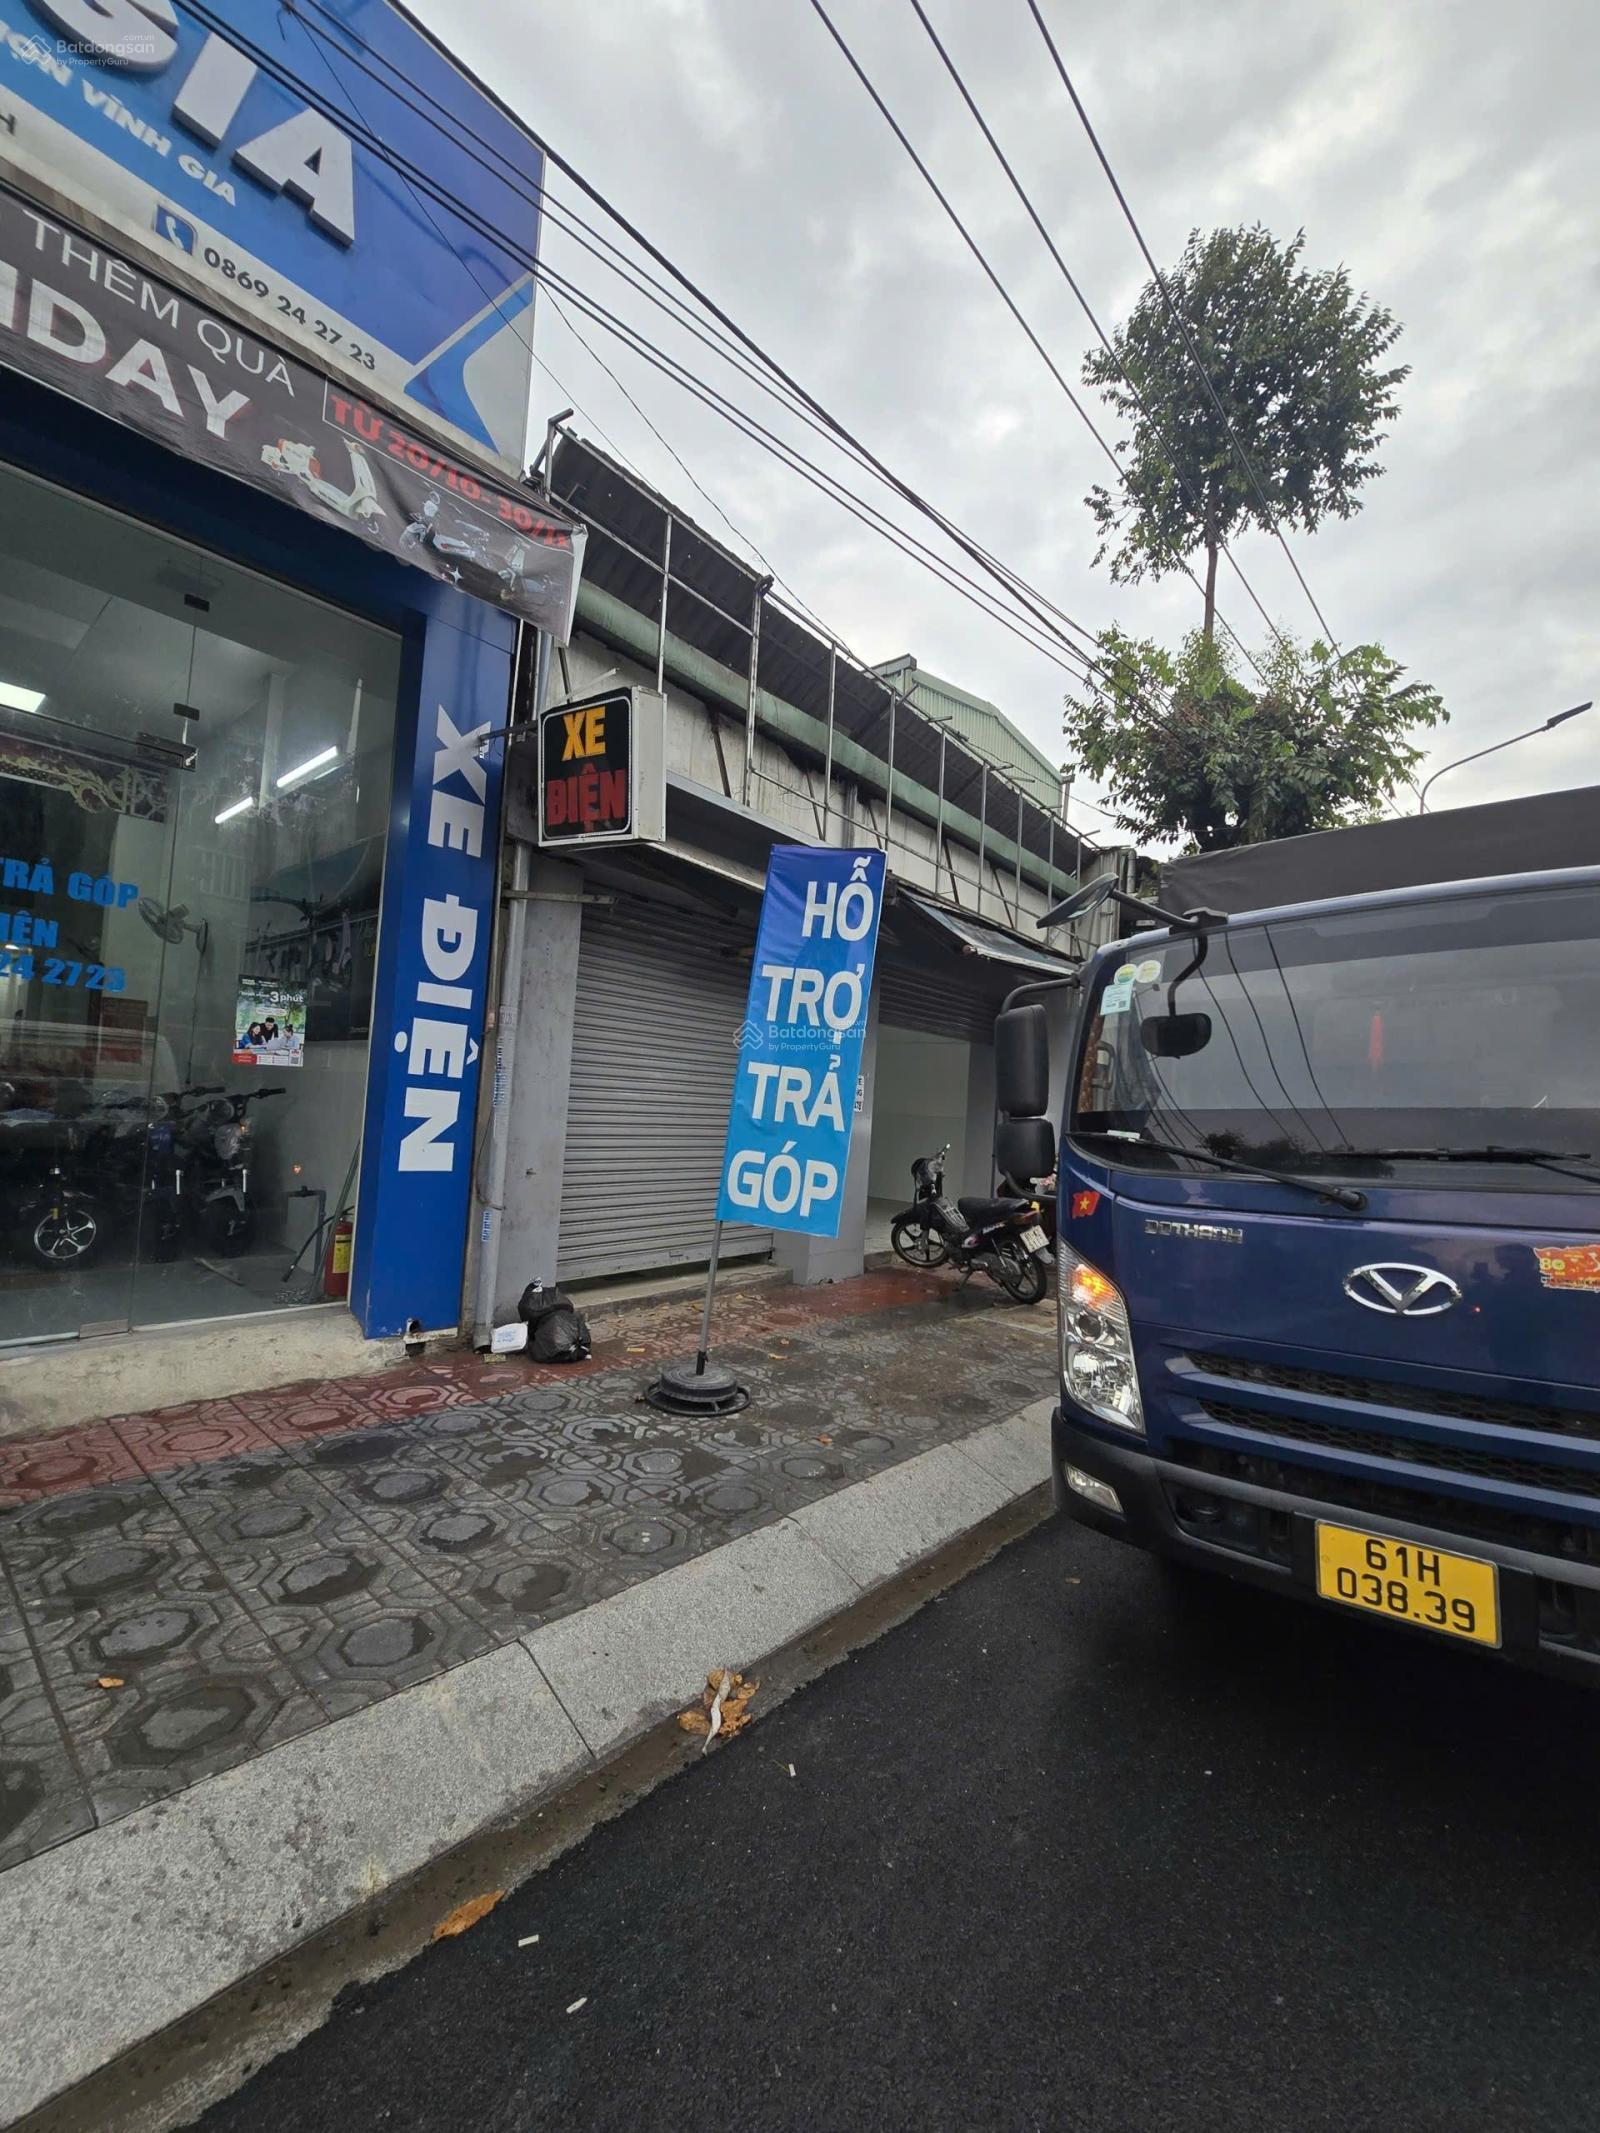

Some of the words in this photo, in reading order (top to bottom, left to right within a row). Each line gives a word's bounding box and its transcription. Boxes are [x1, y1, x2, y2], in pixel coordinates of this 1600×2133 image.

[178, 154, 236, 206] GIA
[22, 208, 180, 329] THÊM
[197, 319, 295, 398] QUÀ
[204, 247, 269, 298] 0869
[277, 295, 306, 325] 24
[314, 320, 343, 345] 27
[350, 343, 375, 370] 23
[562, 706, 606, 761] XE
[428, 704, 492, 858] XE
[0, 857, 55, 896] RẢ
[802, 856, 874, 942] HỖ
[269, 990, 279, 1003] 3
[280, 993, 304, 1004] phút
[395, 894, 479, 1172] ĐIỆN
[762, 963, 865, 1045] TRỢ
[747, 1054, 845, 1133] TRẢ
[727, 1140, 838, 1218] GÓP
[1336, 1567, 1475, 1633] 038.39
[1366, 1538, 1441, 1587] 61H
